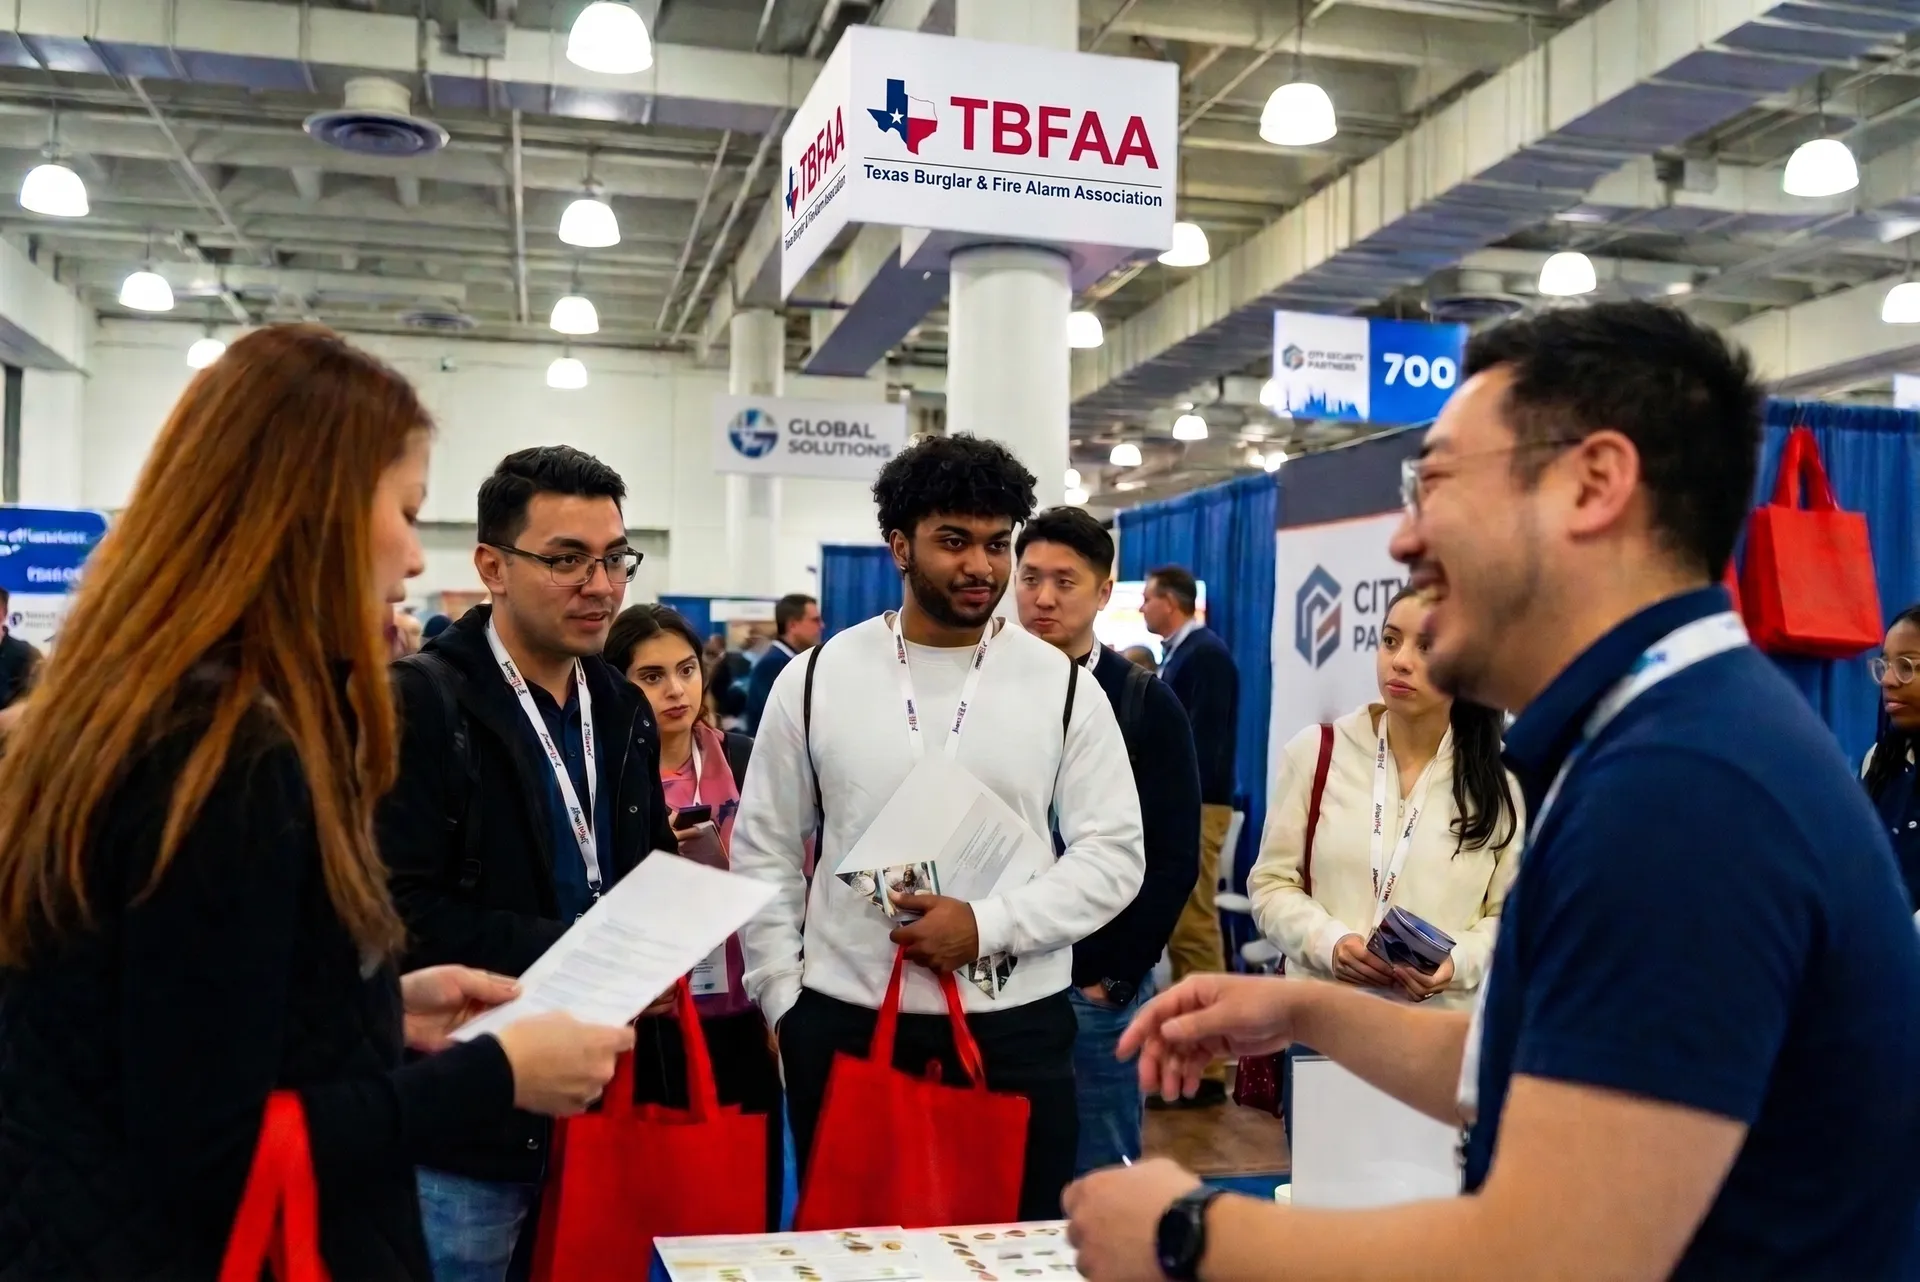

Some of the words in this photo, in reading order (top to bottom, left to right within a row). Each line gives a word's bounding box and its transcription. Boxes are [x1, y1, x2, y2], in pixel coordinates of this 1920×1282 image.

[950, 96, 1159, 170] TBFAA
[800, 106, 845, 201] TBFAA
[863, 164, 909, 183] Texas
[914, 169, 972, 190] Burglar
[976, 175, 988, 190] &
[993, 177, 1022, 194] Fire
[1025, 180, 1070, 198] Alarm
[1074, 185, 1162, 207] Association
[1383, 353, 1457, 390] 700
[788, 418, 876, 439] GLOBAL
[788, 439, 892, 458] SOLUTIONS
[1353, 625, 1380, 652] PA
